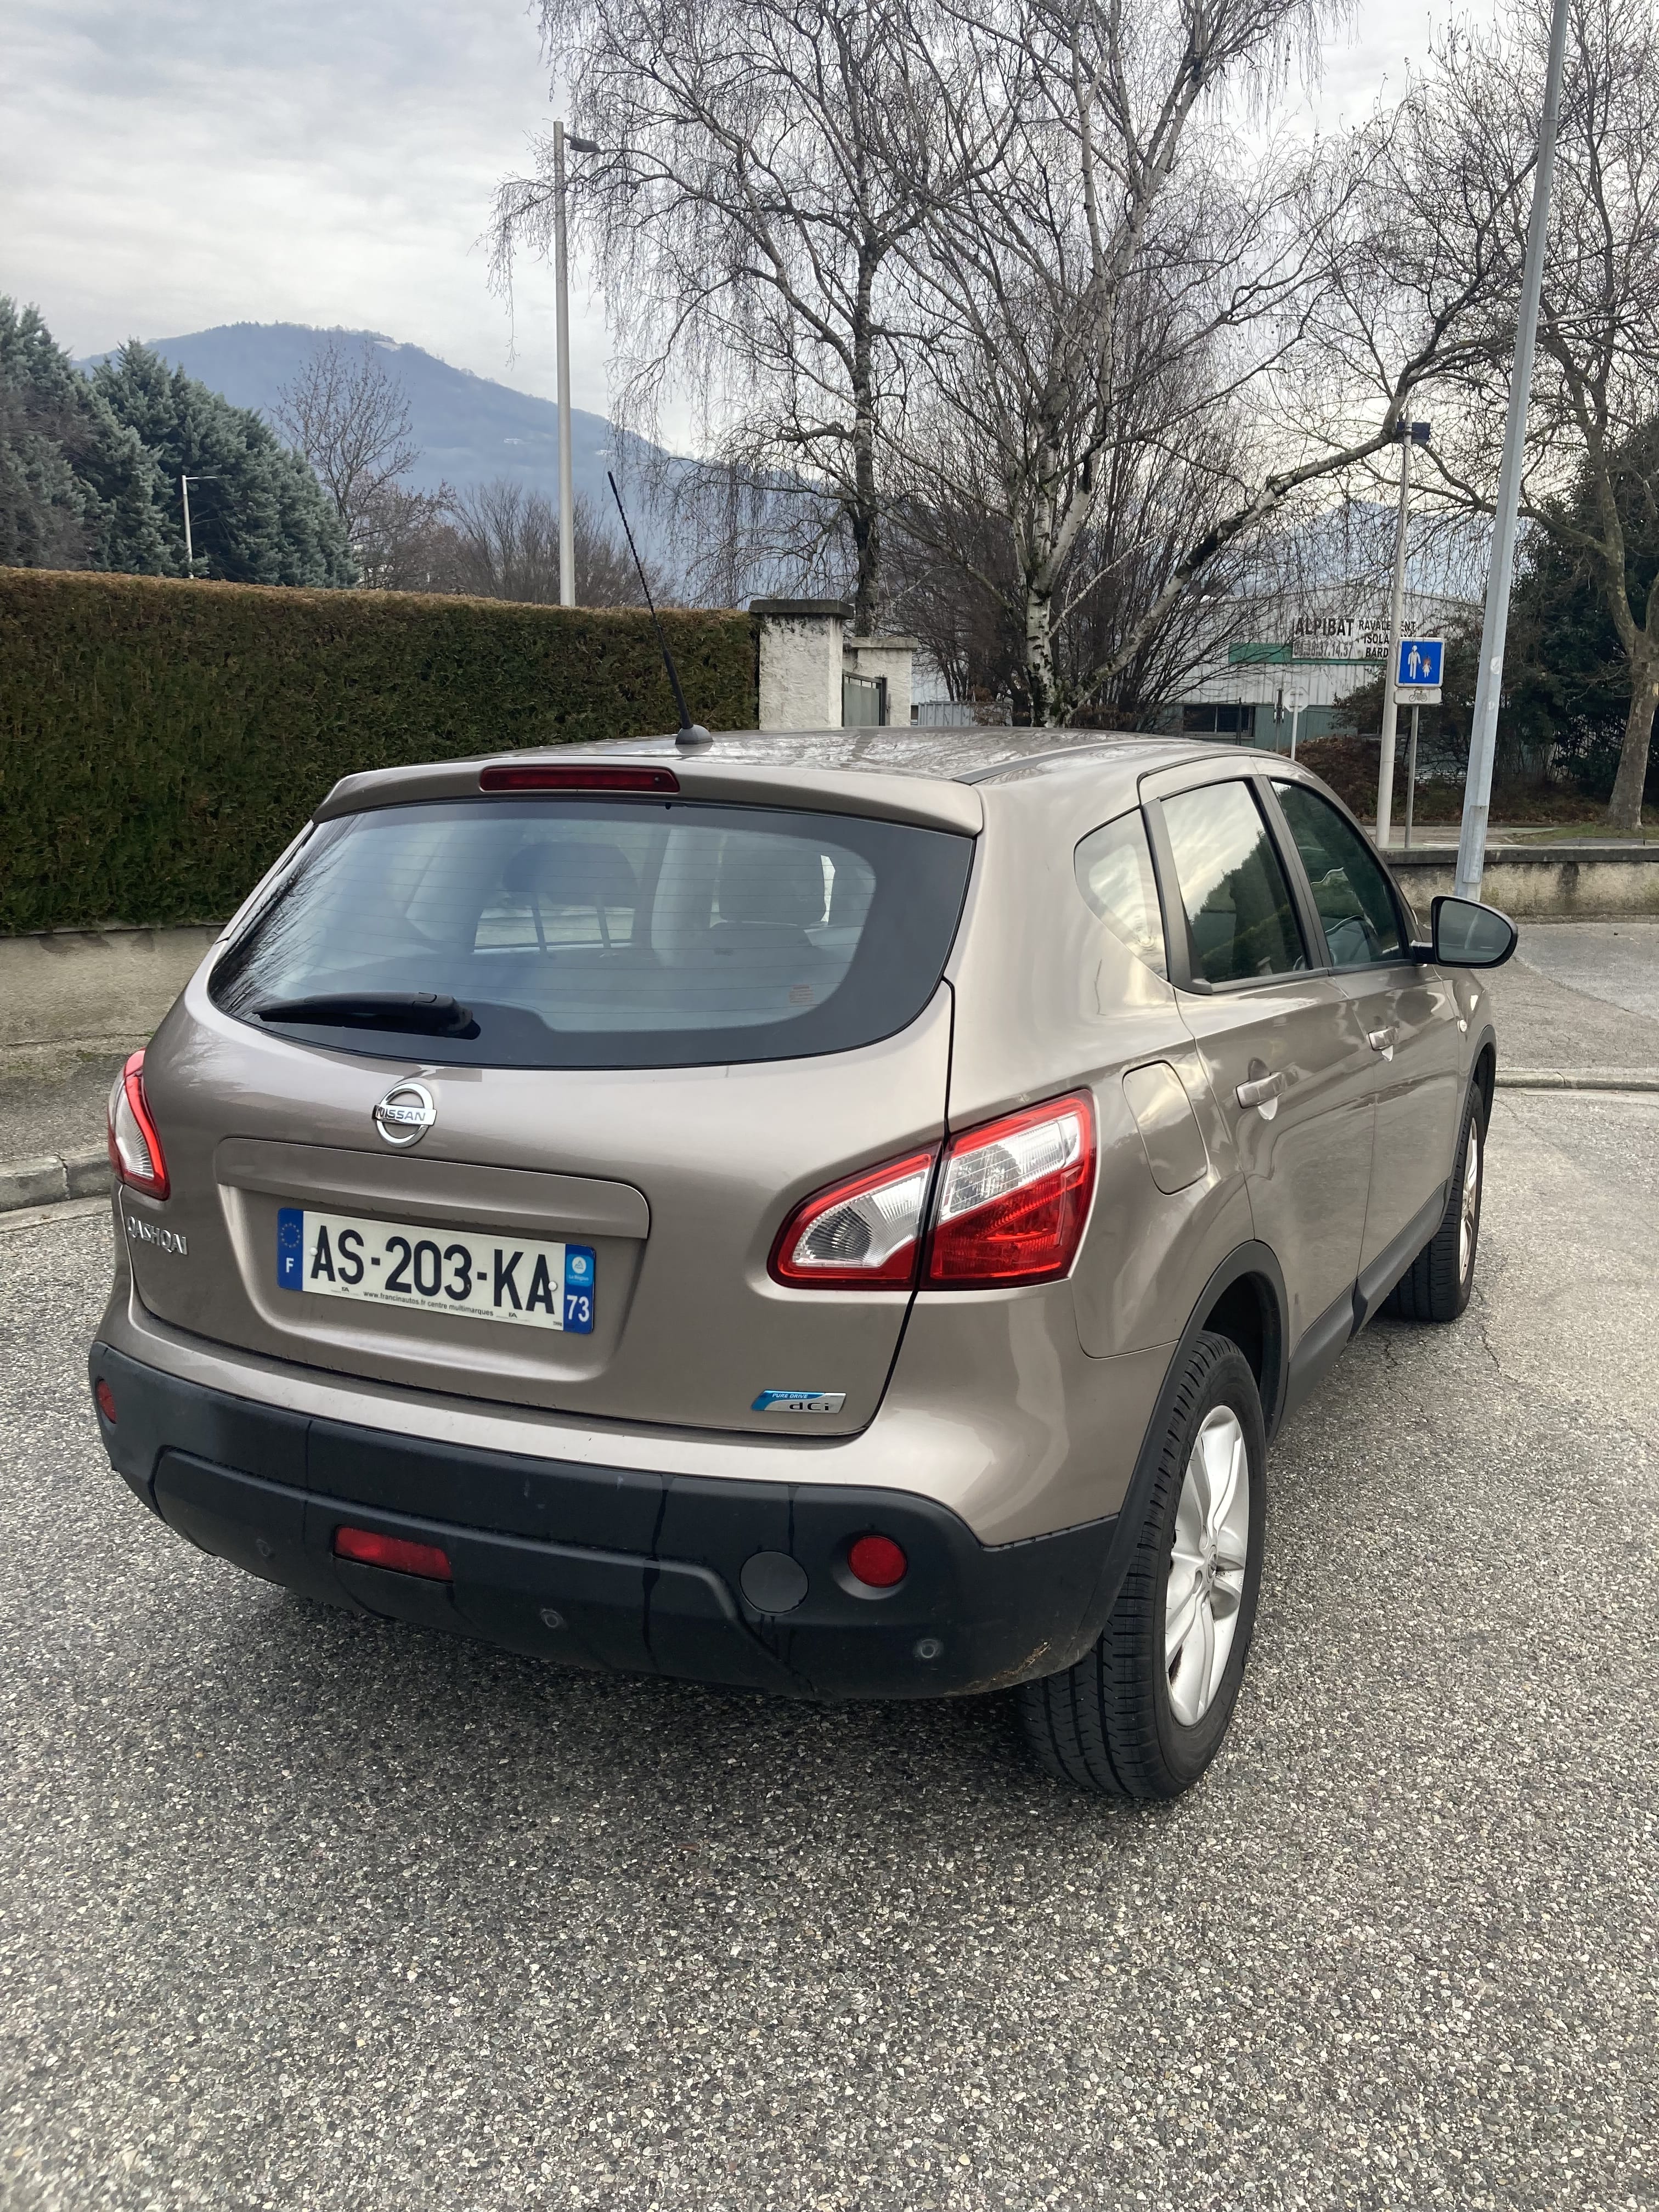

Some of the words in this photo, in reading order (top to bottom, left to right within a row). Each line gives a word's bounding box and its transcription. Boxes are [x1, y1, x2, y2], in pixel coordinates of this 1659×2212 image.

[1294, 618, 1354, 636] ALPIBAT
[1358, 620, 1416, 631] RAVALEENT
[1365, 647, 1389, 658] BARD
[376, 1107, 426, 1121] NISSAN
[127, 1216, 188, 1255] QASHQAI
[286, 1257, 294, 1273] F
[310, 1225, 555, 1314] AS-203-KA
[427, 1301, 448, 1310] centre
[449, 1304, 494, 1316] multimarques
[567, 1294, 590, 1322] 73
[789, 1402, 829, 1411] dCi
